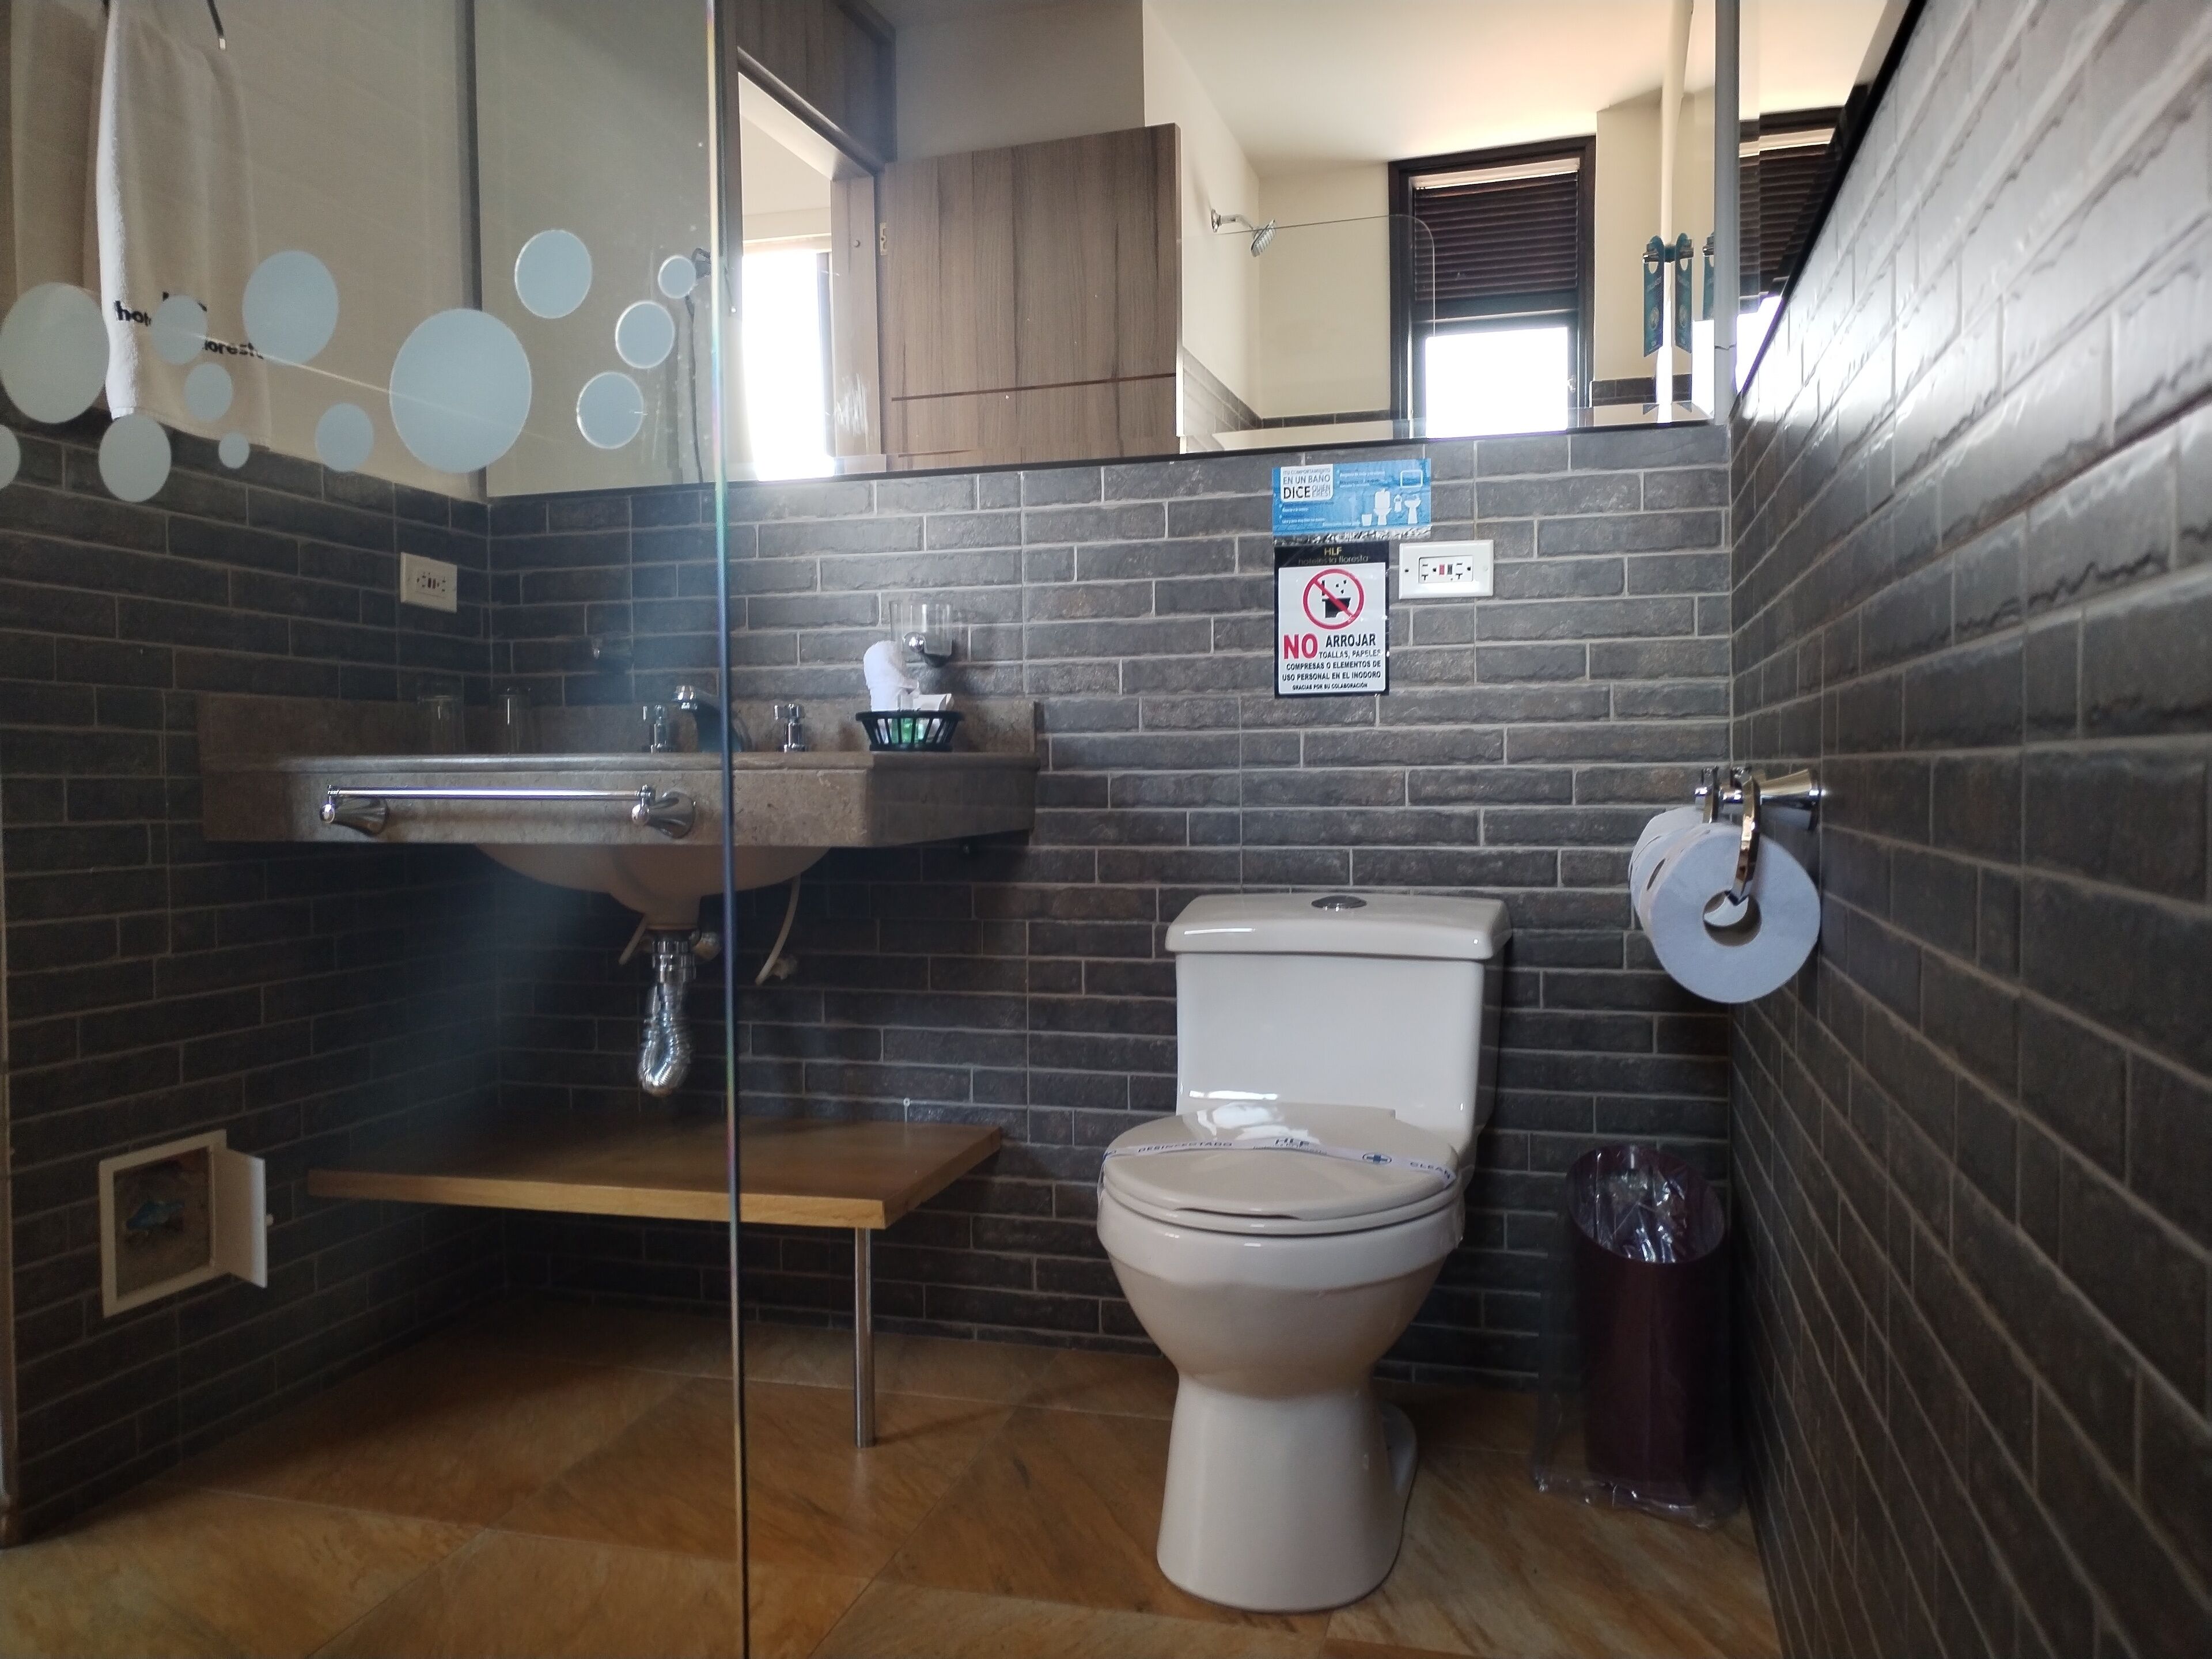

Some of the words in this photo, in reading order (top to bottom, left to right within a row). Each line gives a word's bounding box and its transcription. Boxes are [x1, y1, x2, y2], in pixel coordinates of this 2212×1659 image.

[1283, 476, 1293, 484] EN
[1296, 476, 1306, 484] UN
[1283, 486, 1310, 499] DICE
[1324, 547, 1342, 555] HLF
[1339, 554, 1369, 564] floresta
[1283, 634, 1318, 660] NO
[1325, 633, 1376, 647] ARROJAR
[1319, 651, 1350, 660] TOALLAS,
[1286, 662, 1324, 671] COMPRESAS
[1332, 661, 1370, 669] ELEMENTOS
[1297, 673, 1330, 681] PERSONAL
[1352, 671, 1381, 679] INODORO
[1331, 681, 1368, 690] COLABORACIÓN
[1138, 1141, 1233, 1153] DESINFECTADO
[1275, 1137, 1309, 1148] HLF
